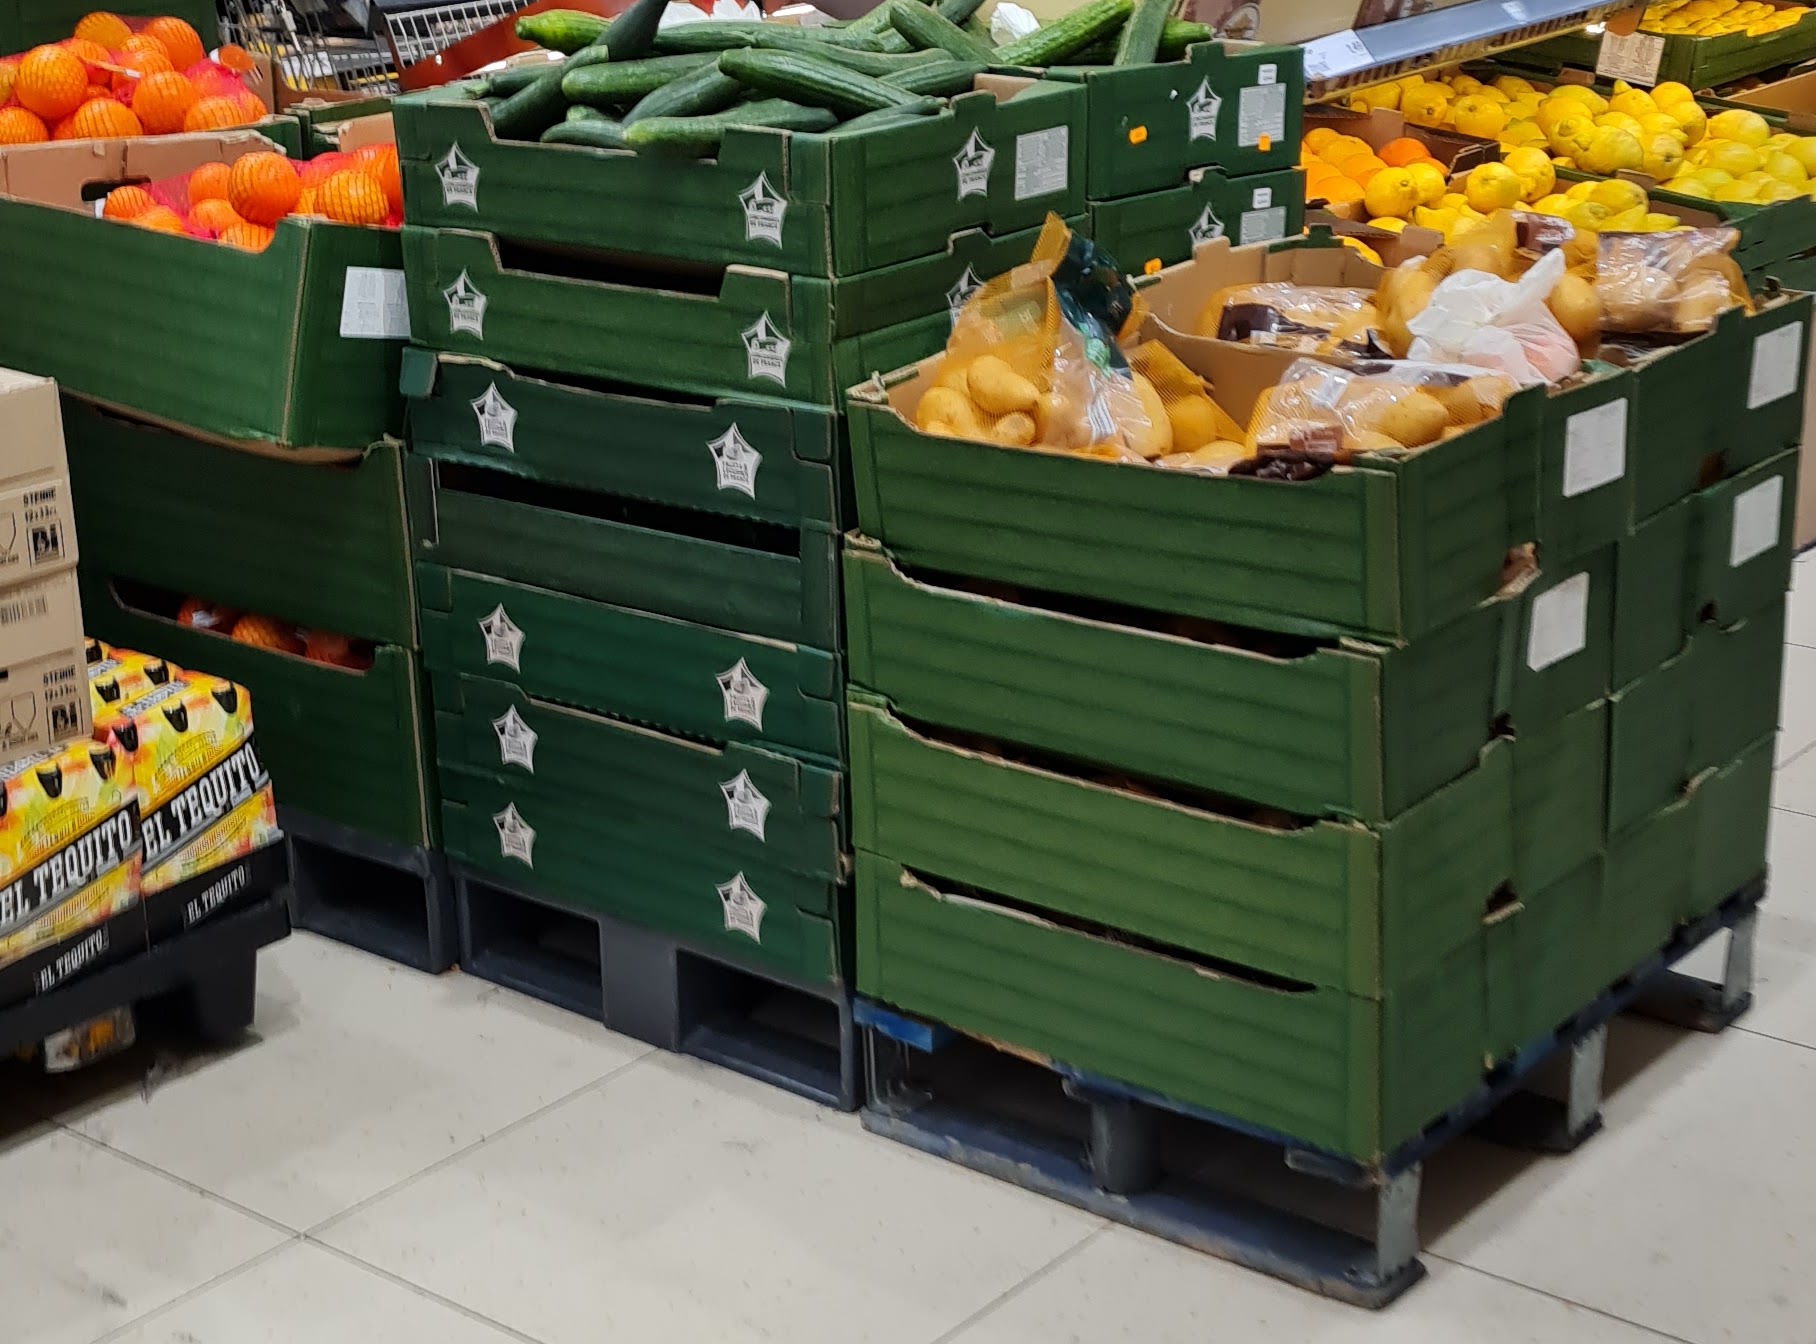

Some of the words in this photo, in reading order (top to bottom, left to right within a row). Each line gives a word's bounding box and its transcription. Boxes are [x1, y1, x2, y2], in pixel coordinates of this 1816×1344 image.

[141, 817, 173, 863] EL
[170, 742, 261, 836] TEQUITO
[0, 885, 31, 925] EL
[33, 809, 133, 901] TEQUITO
[187, 897, 201, 924] EL
[201, 864, 247, 912] TEQUITO
[40, 965, 56, 993] EL
[55, 928, 104, 978] TEQUITO
